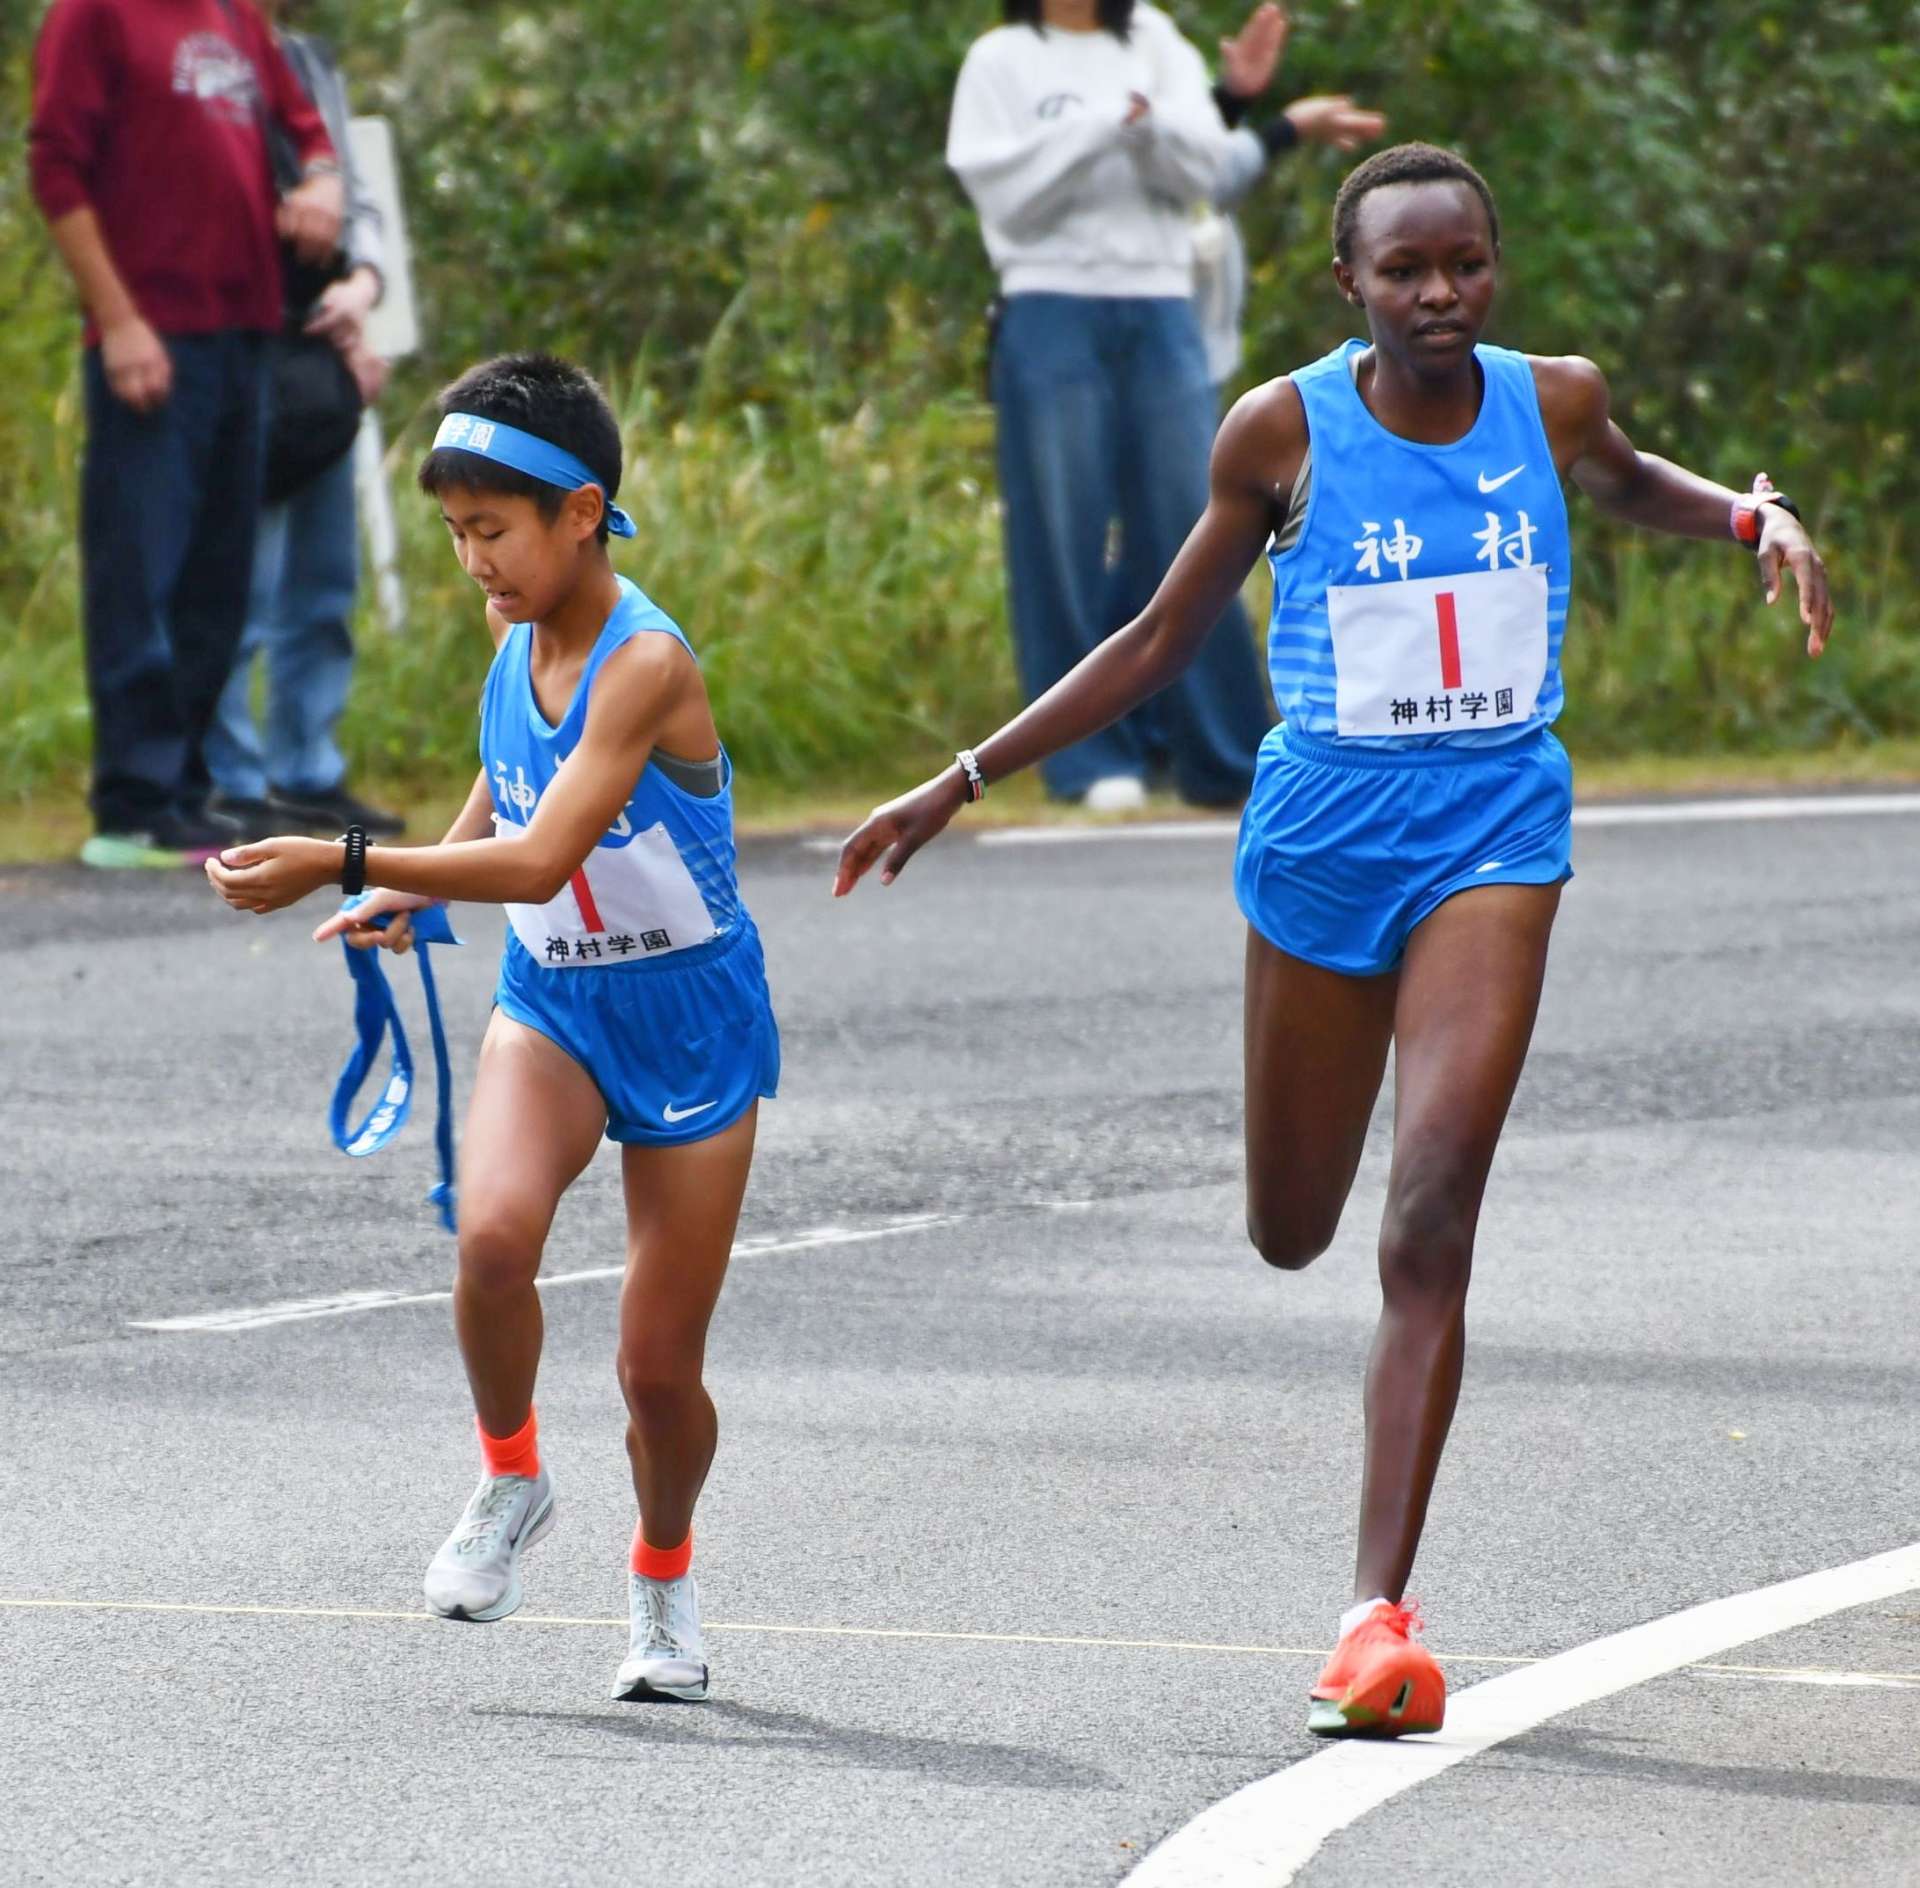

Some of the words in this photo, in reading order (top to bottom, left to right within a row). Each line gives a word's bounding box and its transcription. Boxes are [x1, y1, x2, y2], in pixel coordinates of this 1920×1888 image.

[1435, 591, 1463, 690] 1
[1390, 687, 1514, 726] 神村学園
[545, 928, 673, 963] 神村学園
